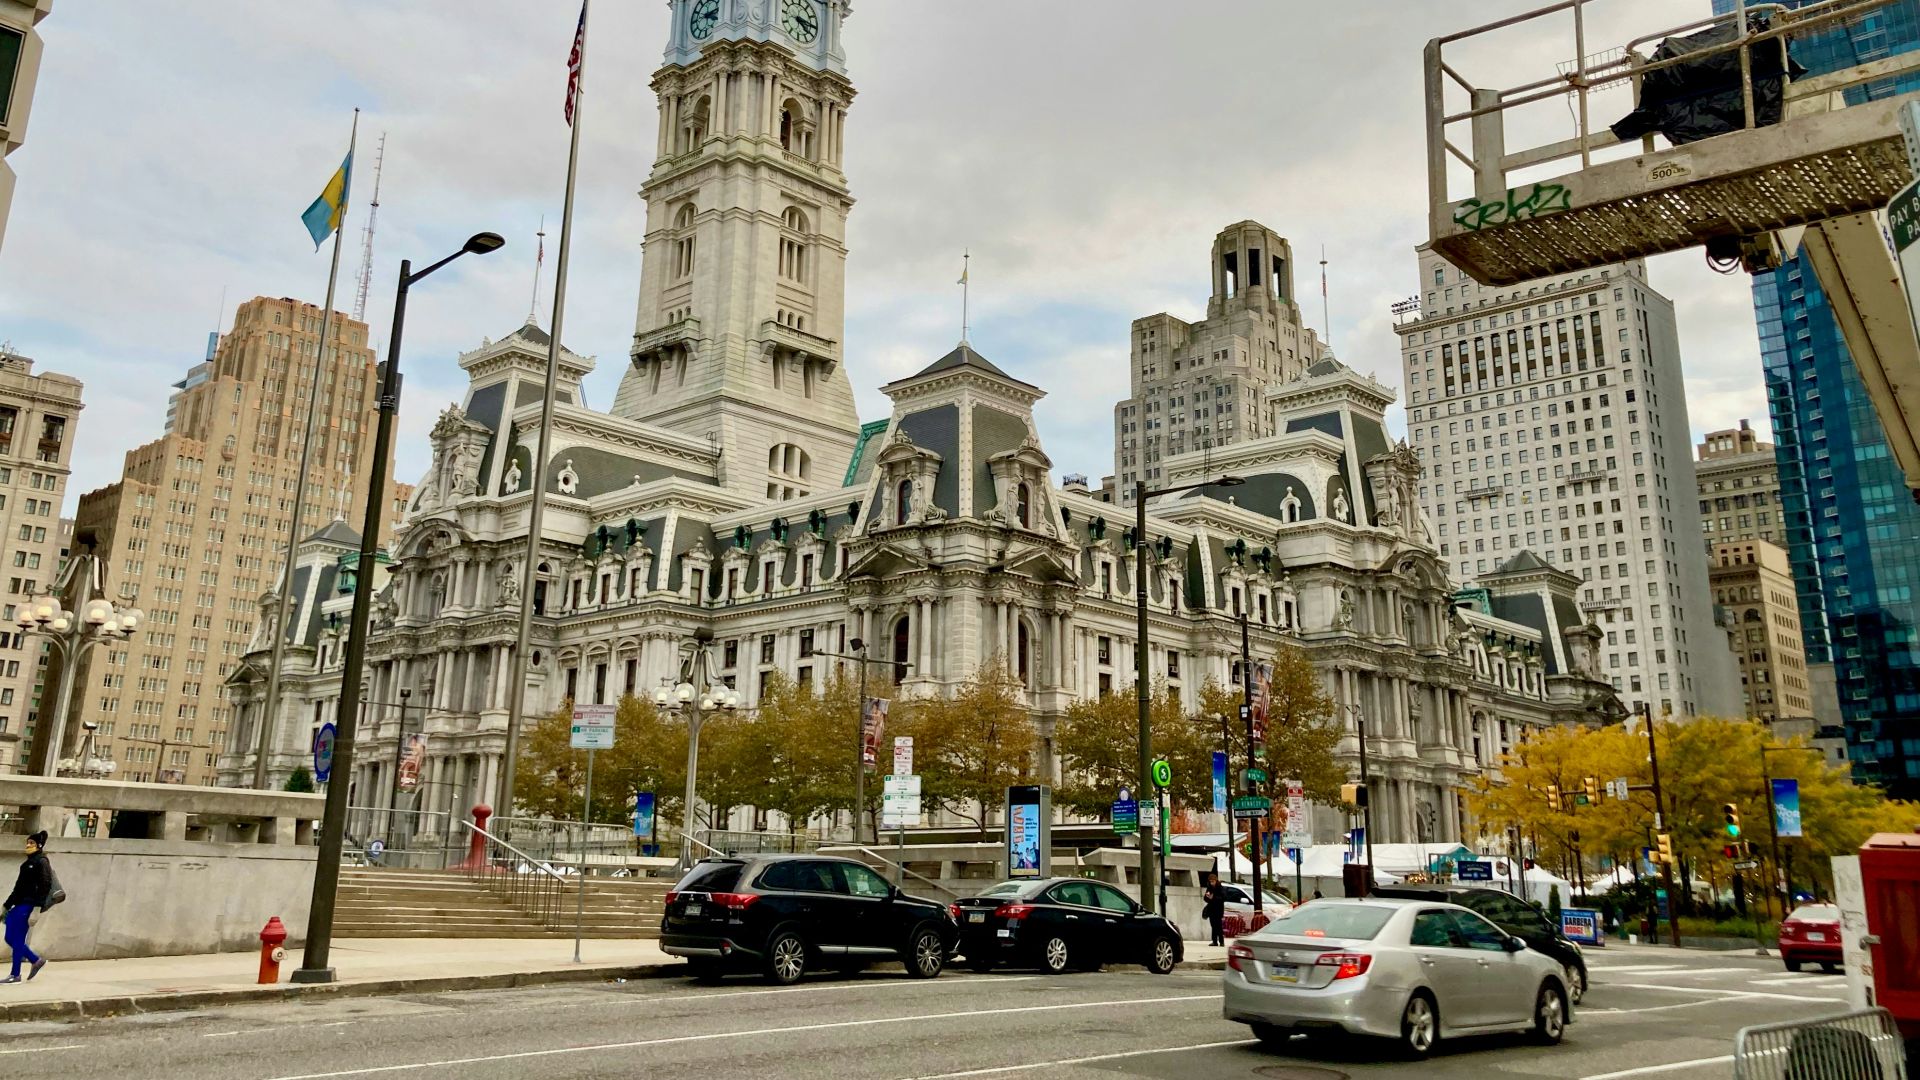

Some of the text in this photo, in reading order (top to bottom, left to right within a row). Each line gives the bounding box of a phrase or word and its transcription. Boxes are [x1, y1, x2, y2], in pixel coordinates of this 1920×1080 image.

[1652, 168, 1672, 180] 500
[1890, 204, 1909, 230] PAY
[1565, 917, 1592, 927] BARBERA
